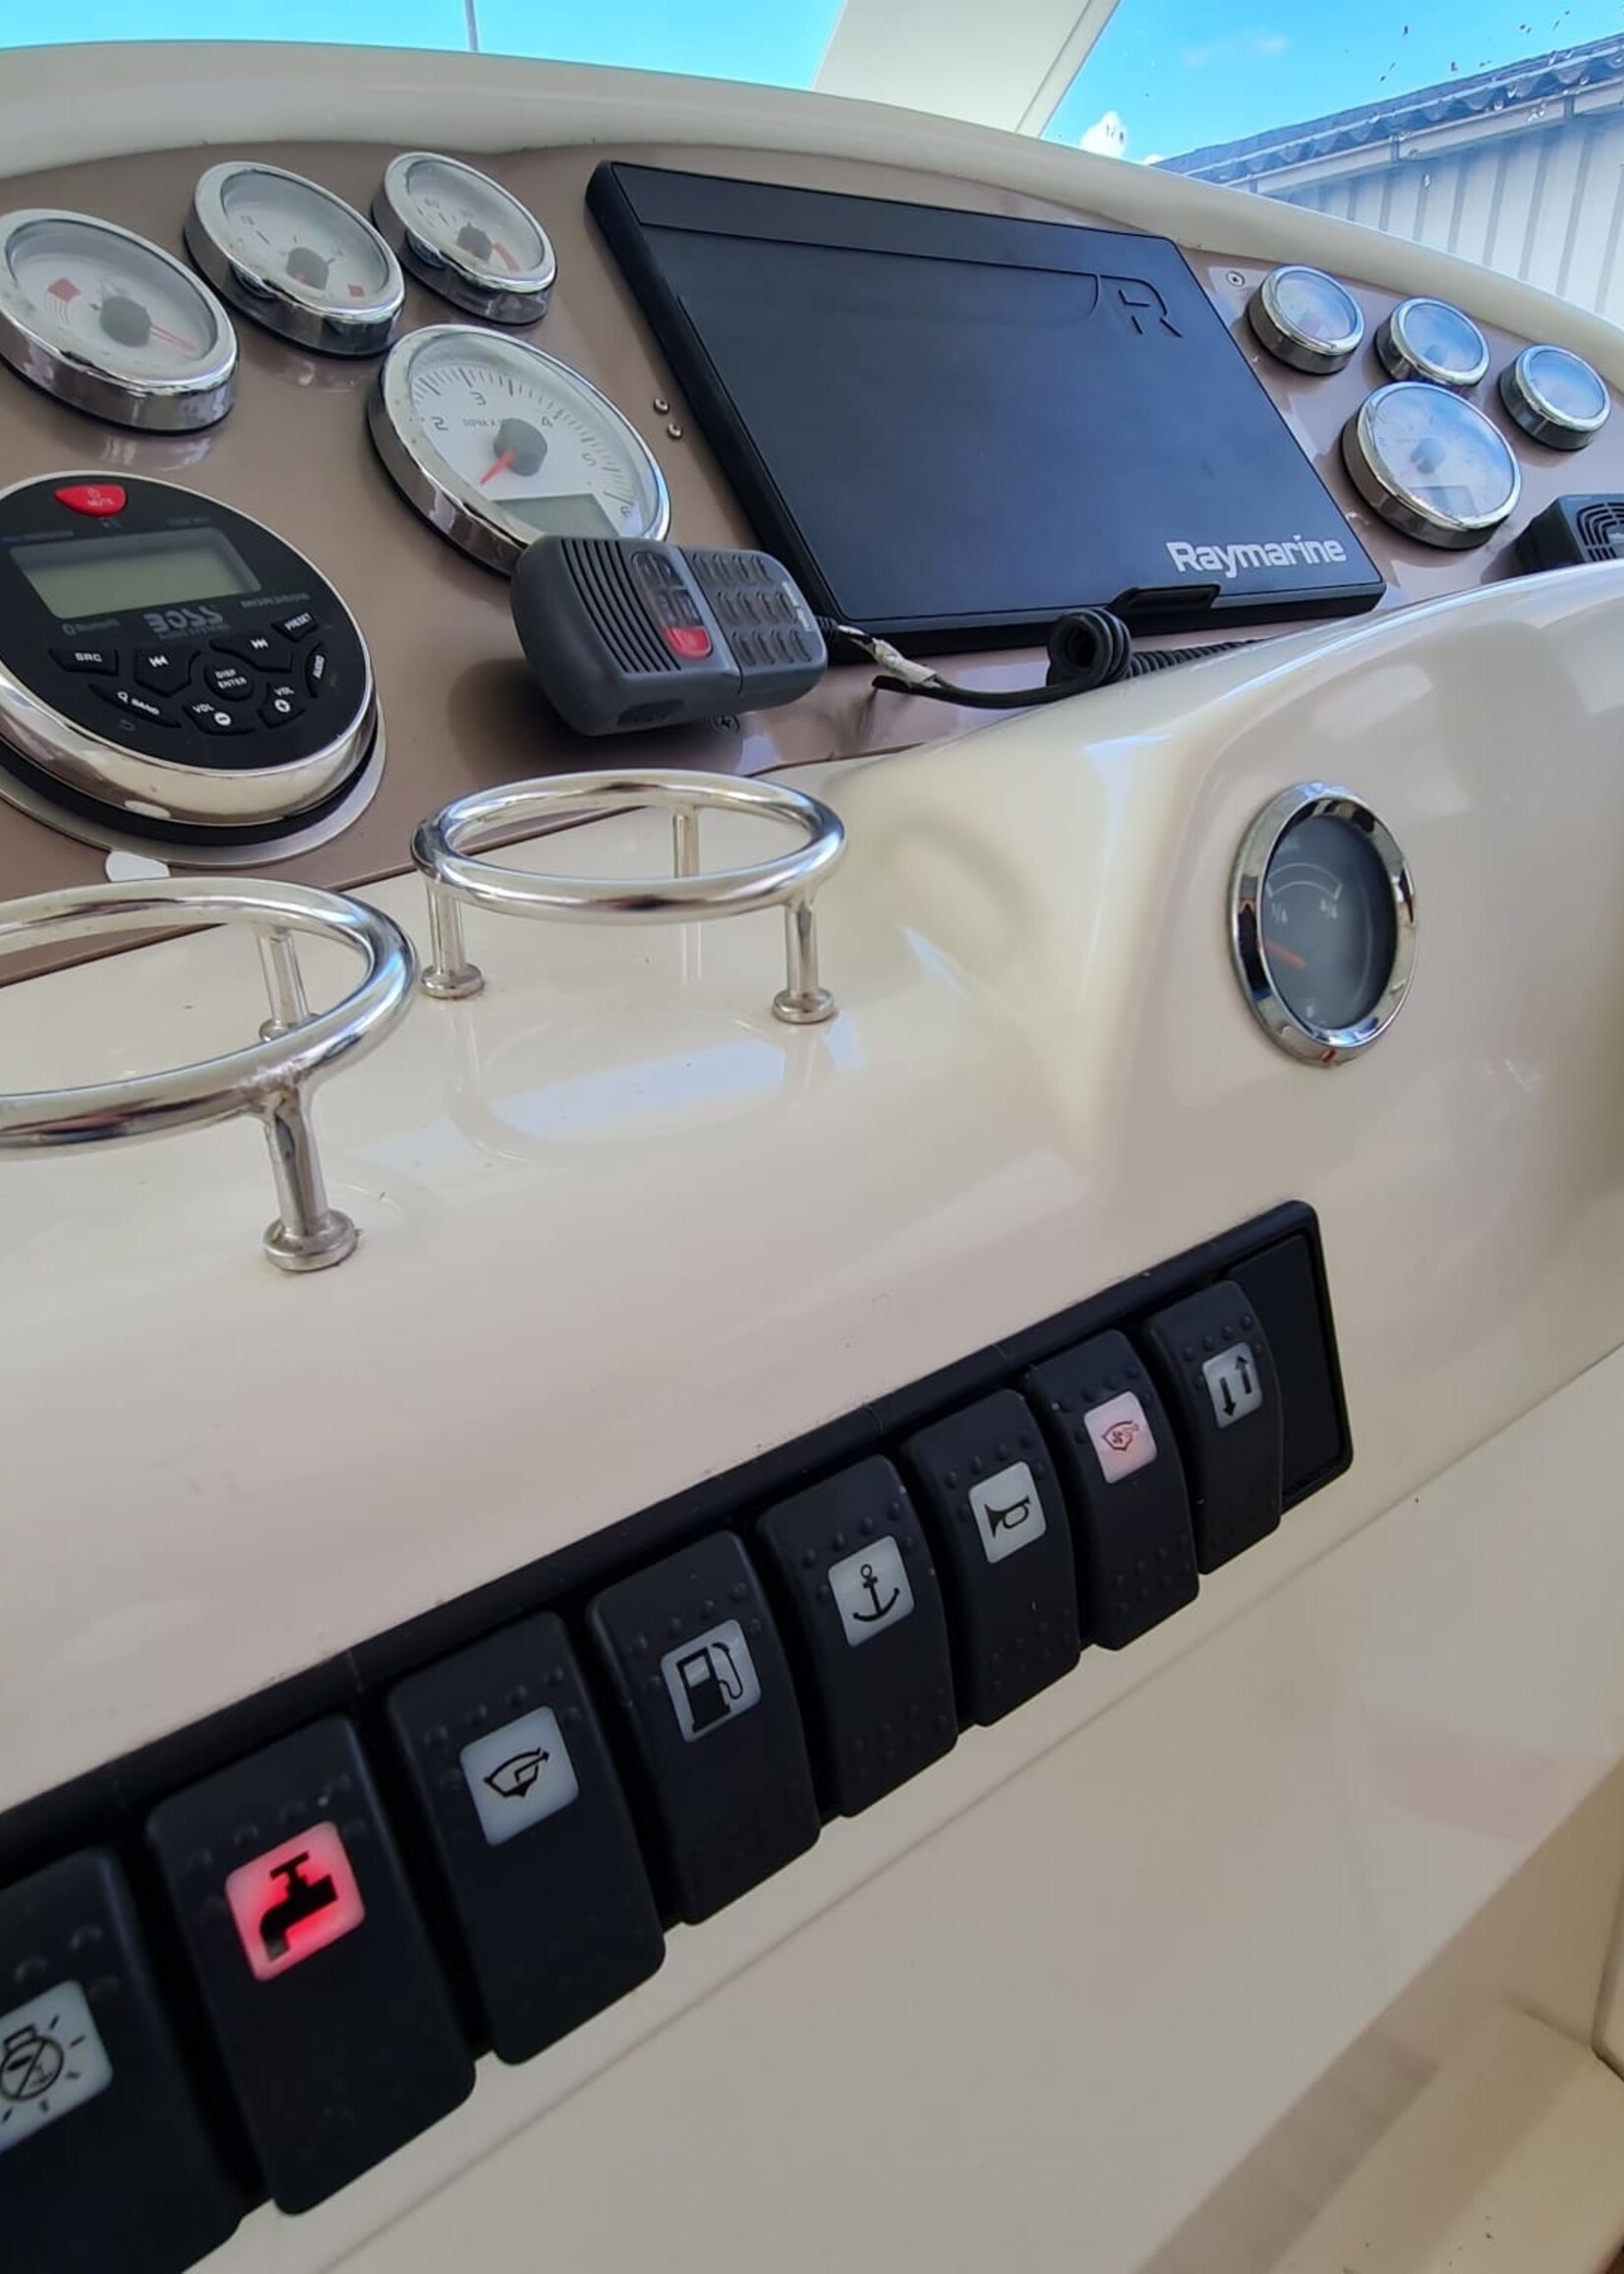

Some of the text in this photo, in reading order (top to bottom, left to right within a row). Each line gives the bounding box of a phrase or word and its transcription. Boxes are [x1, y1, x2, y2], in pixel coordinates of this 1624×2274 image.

[469, 391, 487, 406] 3
[431, 415, 449, 431] 2
[541, 416, 553, 429] 4
[581, 452, 597, 467] 5
[1165, 534, 1347, 578] Raymarine
[75, 652, 102, 663] SRC
[217, 676, 247, 689] ENTER
[273, 686, 295, 697] VOL
[192, 703, 215, 714] VOL
